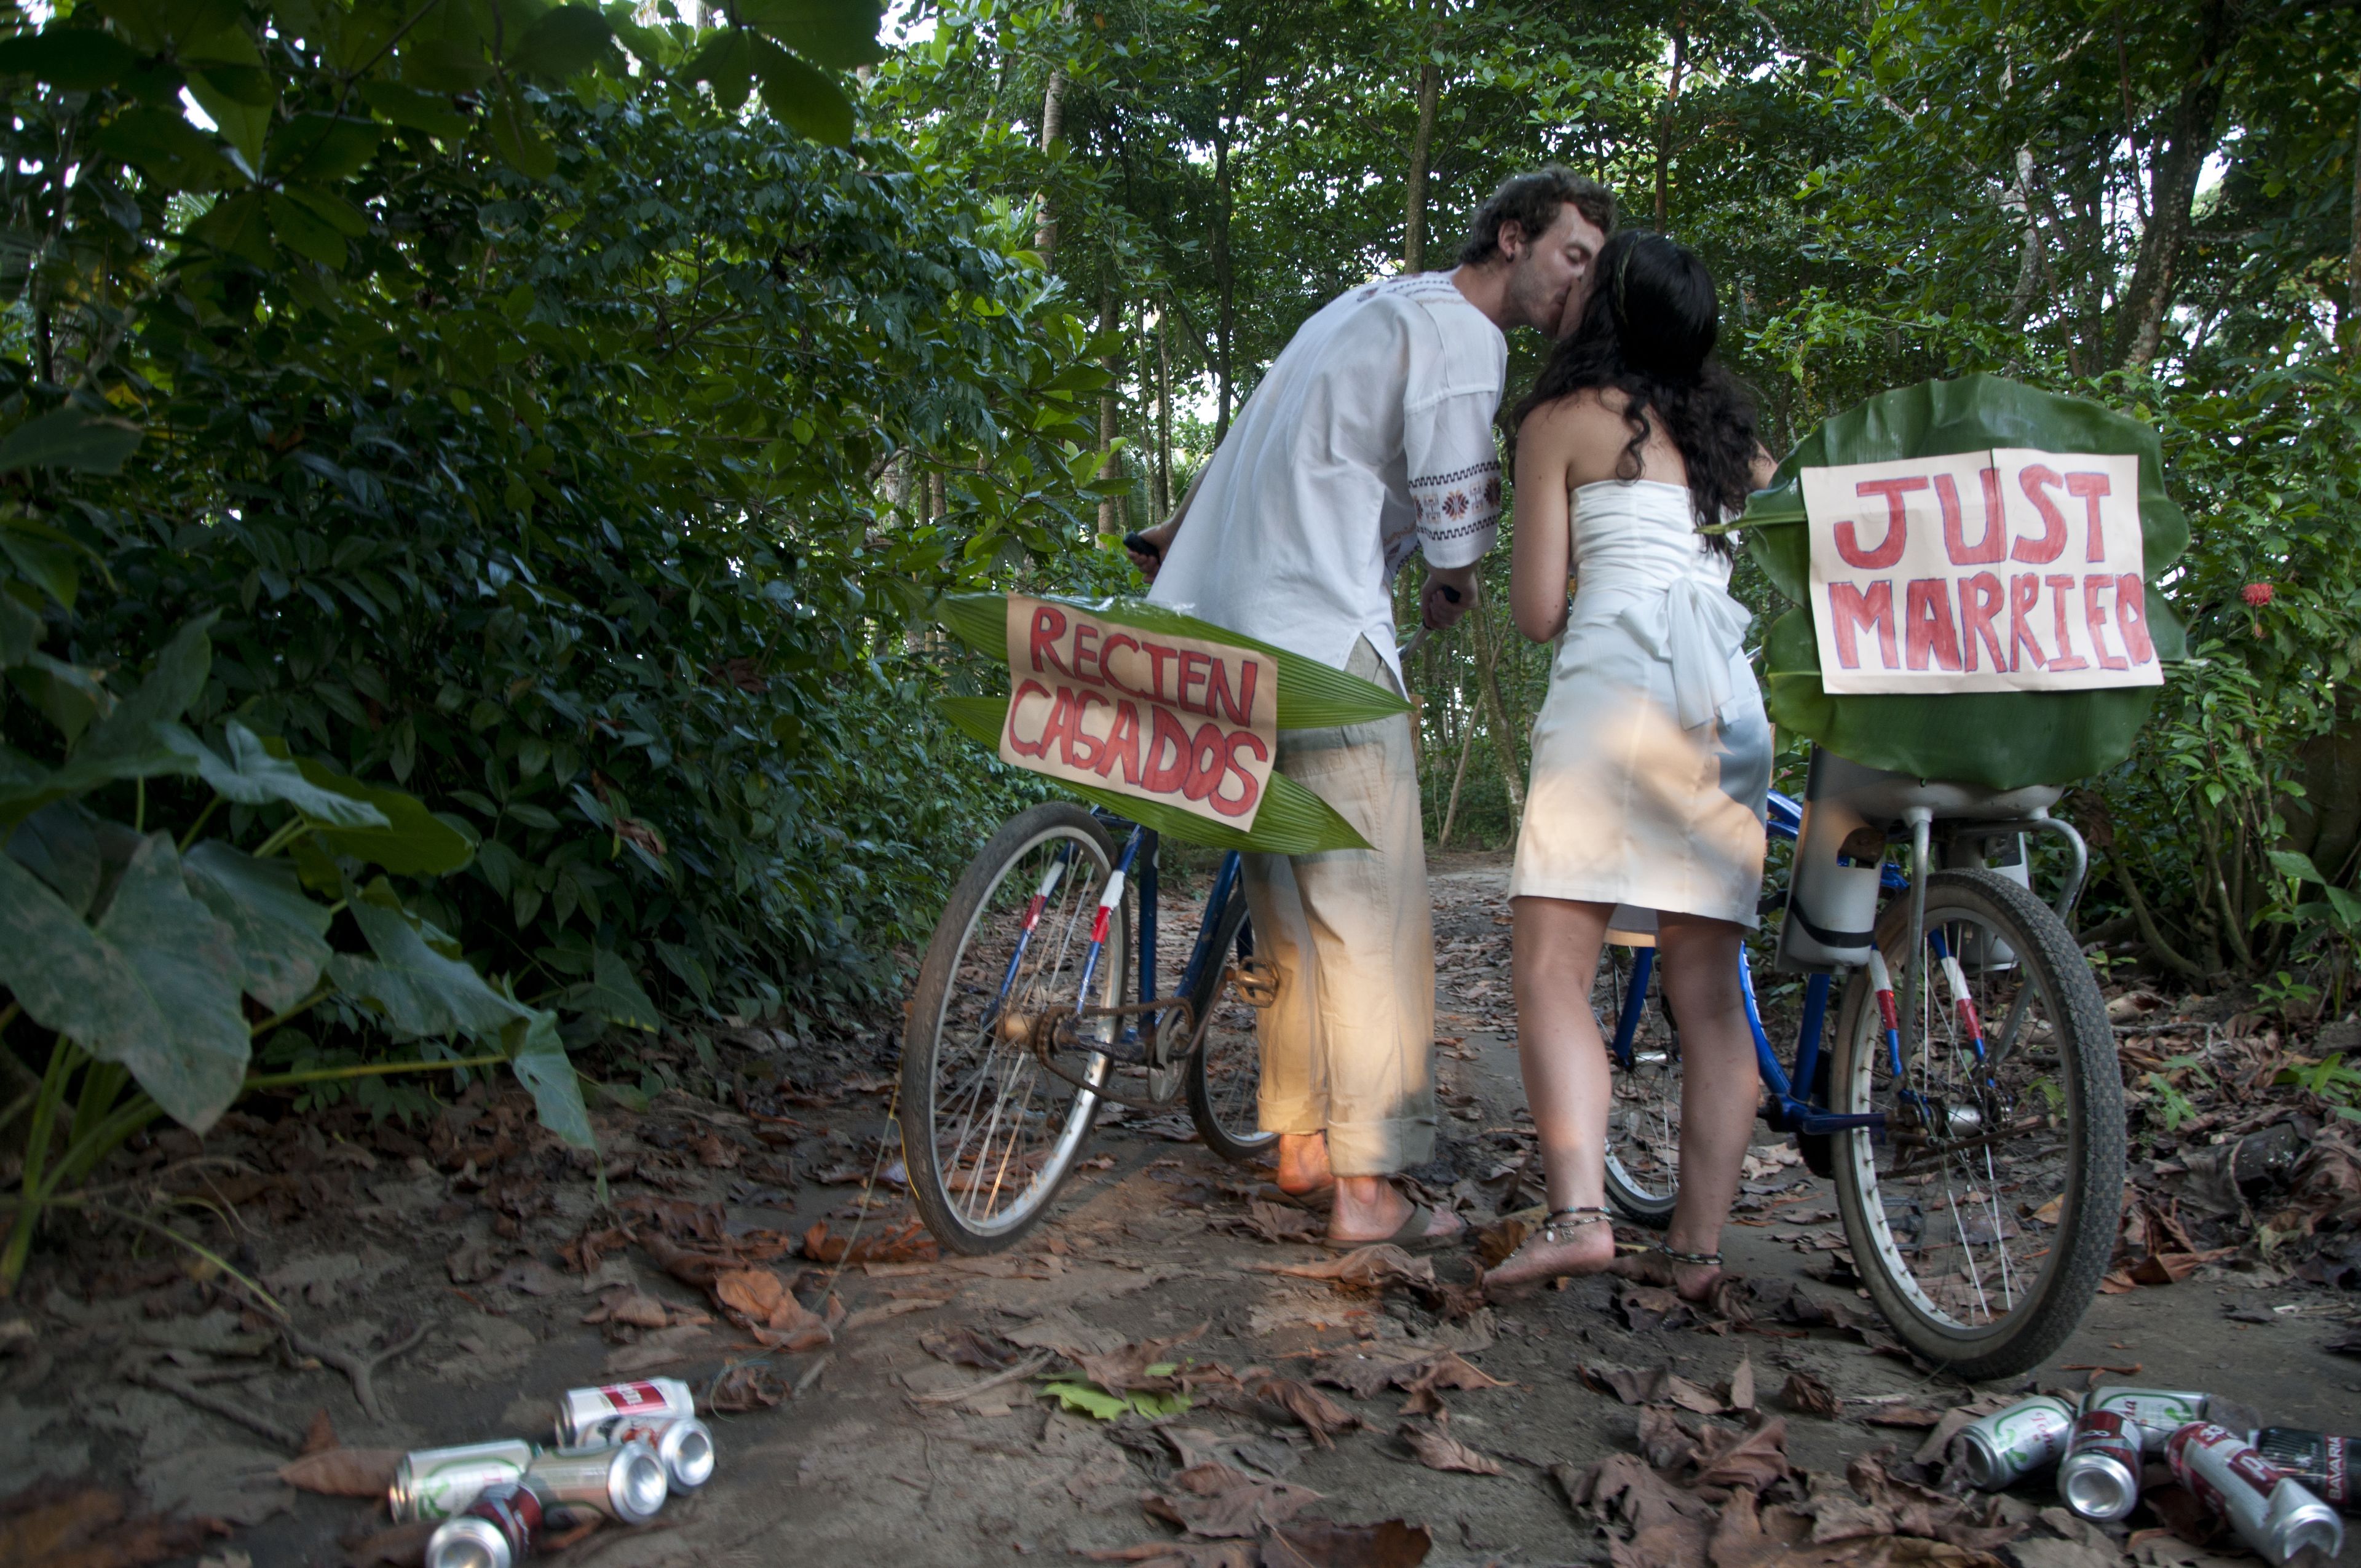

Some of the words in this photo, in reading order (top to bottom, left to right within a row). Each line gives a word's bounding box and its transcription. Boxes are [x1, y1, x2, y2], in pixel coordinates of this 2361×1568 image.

[1833, 463, 2112, 570] JUST
[1029, 606, 1259, 728] RECIEN
[1827, 571, 2153, 673] MARRIED
[1008, 678, 1268, 818] CASADOS
